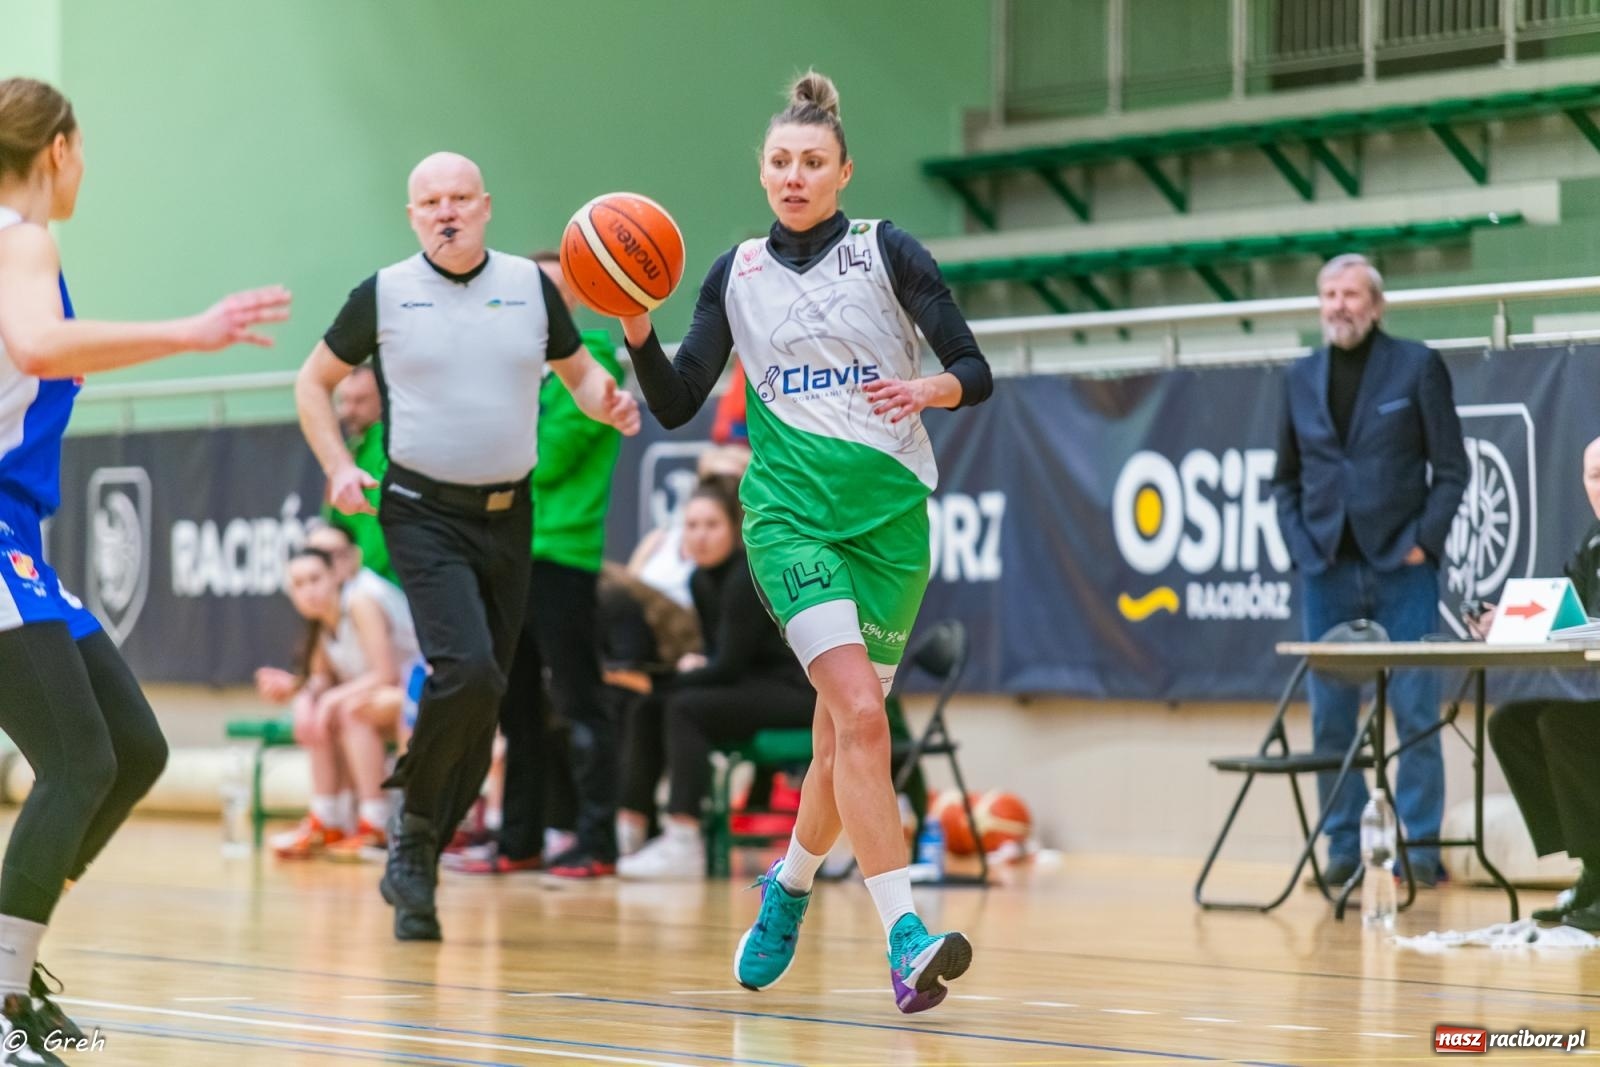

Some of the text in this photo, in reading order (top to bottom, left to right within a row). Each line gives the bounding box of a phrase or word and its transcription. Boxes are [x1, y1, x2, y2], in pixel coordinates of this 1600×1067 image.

[608, 219, 661, 280] molten
[837, 244, 872, 275] 14
[783, 359, 880, 395] Clavis
[783, 561, 831, 602] 14
